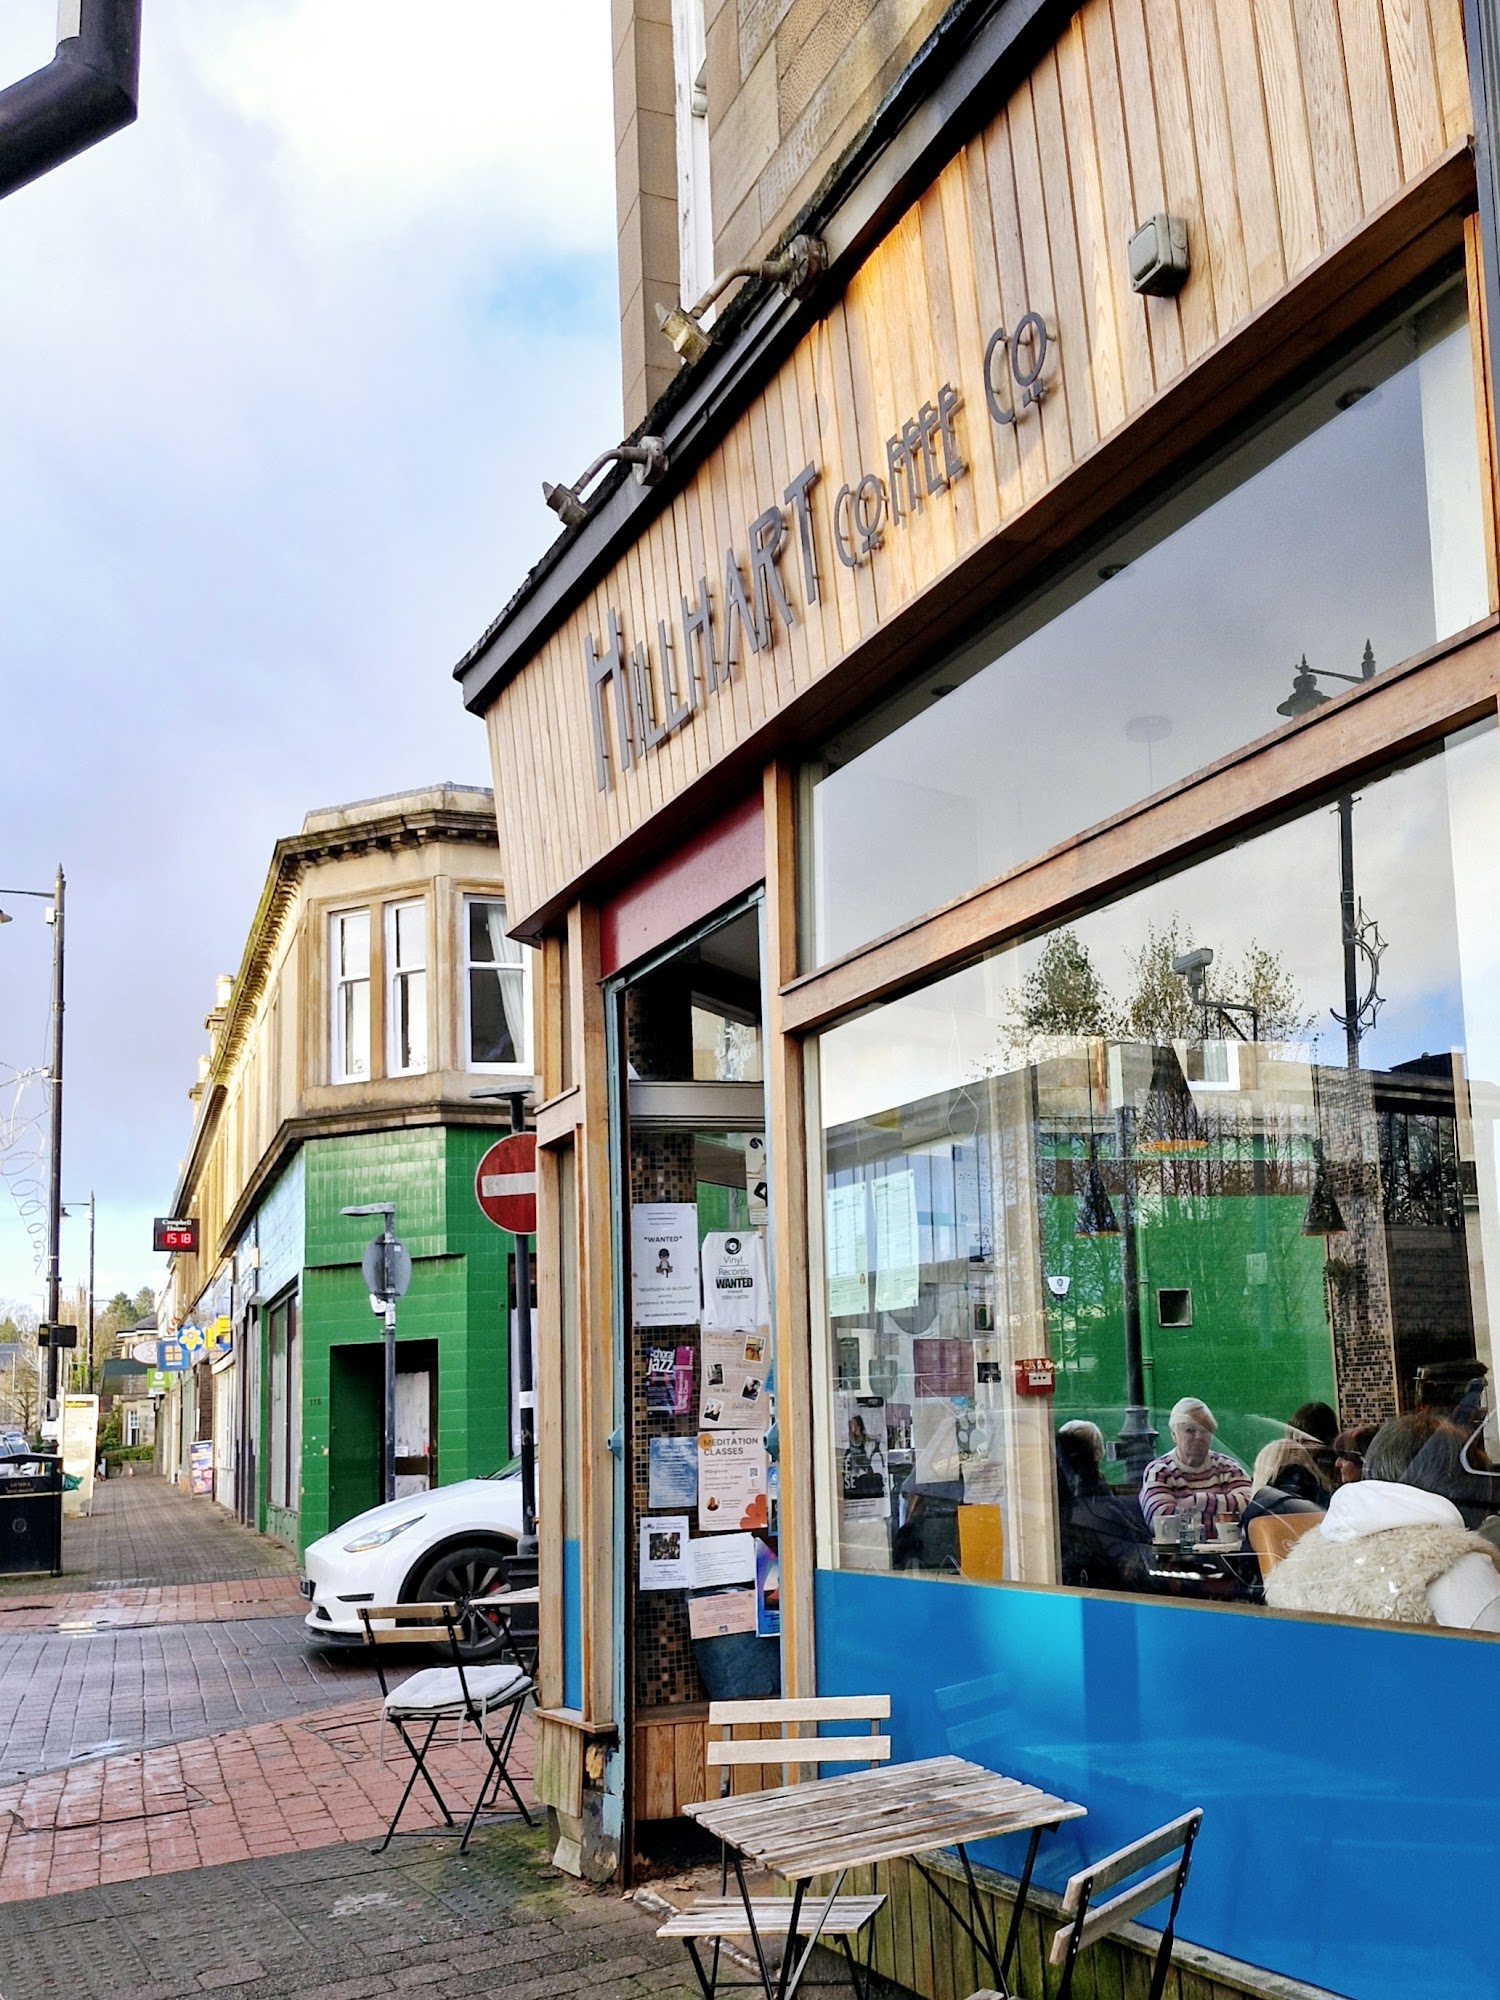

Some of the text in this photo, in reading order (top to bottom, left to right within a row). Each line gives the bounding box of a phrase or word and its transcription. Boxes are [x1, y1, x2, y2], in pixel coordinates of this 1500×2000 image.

[584, 311, 1047, 793] HILLHART COFFEE CO
[167, 1233, 192, 1244] 15 18
[723, 1255, 743, 1266] Vinyl
[718, 1267, 750, 1276] Records
[715, 1277, 754, 1289] WANTED
[653, 1347, 676, 1360] choral
[645, 1357, 675, 1376] jazz
[703, 1437, 759, 1448] MEDITATION
[703, 1446, 744, 1456] CLASSES
